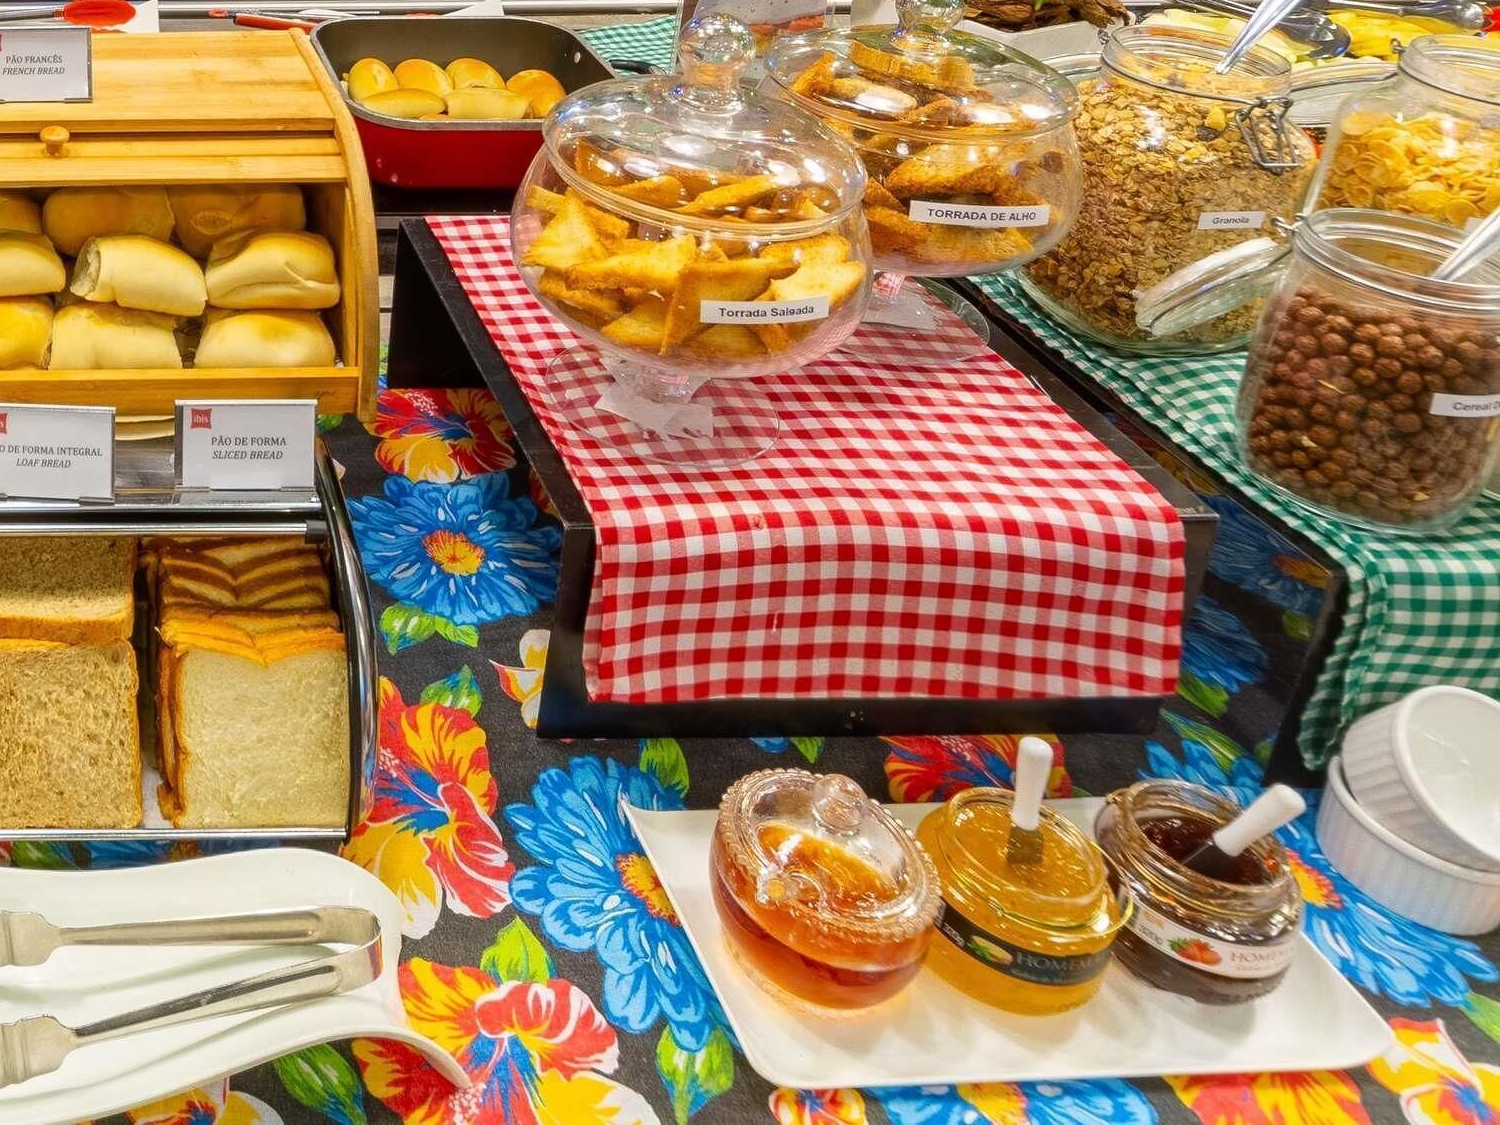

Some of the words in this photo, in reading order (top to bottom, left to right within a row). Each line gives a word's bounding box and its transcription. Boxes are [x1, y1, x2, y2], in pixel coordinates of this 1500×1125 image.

[5, 54, 23, 64] PÃO
[25, 53, 63, 64] FRANCÊS
[2, 67, 35, 75] FRENCH
[37, 66, 65, 75] BREAD
[927, 208, 987, 221] TORRADA
[990, 212, 1007, 221] DE
[1008, 211, 1037, 221] ALHO
[1212, 216, 1250, 225] Granola
[718, 307, 767, 318] Torrada
[770, 305, 814, 317] Salgada
[1452, 401, 1492, 412] Cereal
[193, 414, 208, 424] ibis
[211, 435, 232, 446] PÃO
[234, 437, 248, 446] DE
[250, 436, 287, 446] FORMA
[8, 445, 20, 454] DE
[22, 445, 55, 455] FORMA
[57, 446, 103, 456] INTEGRAL
[212, 450, 247, 460] SLICED
[249, 450, 284, 460] BREAD
[16, 458, 41, 467] LOAF
[41, 459, 71, 468] BREAD
